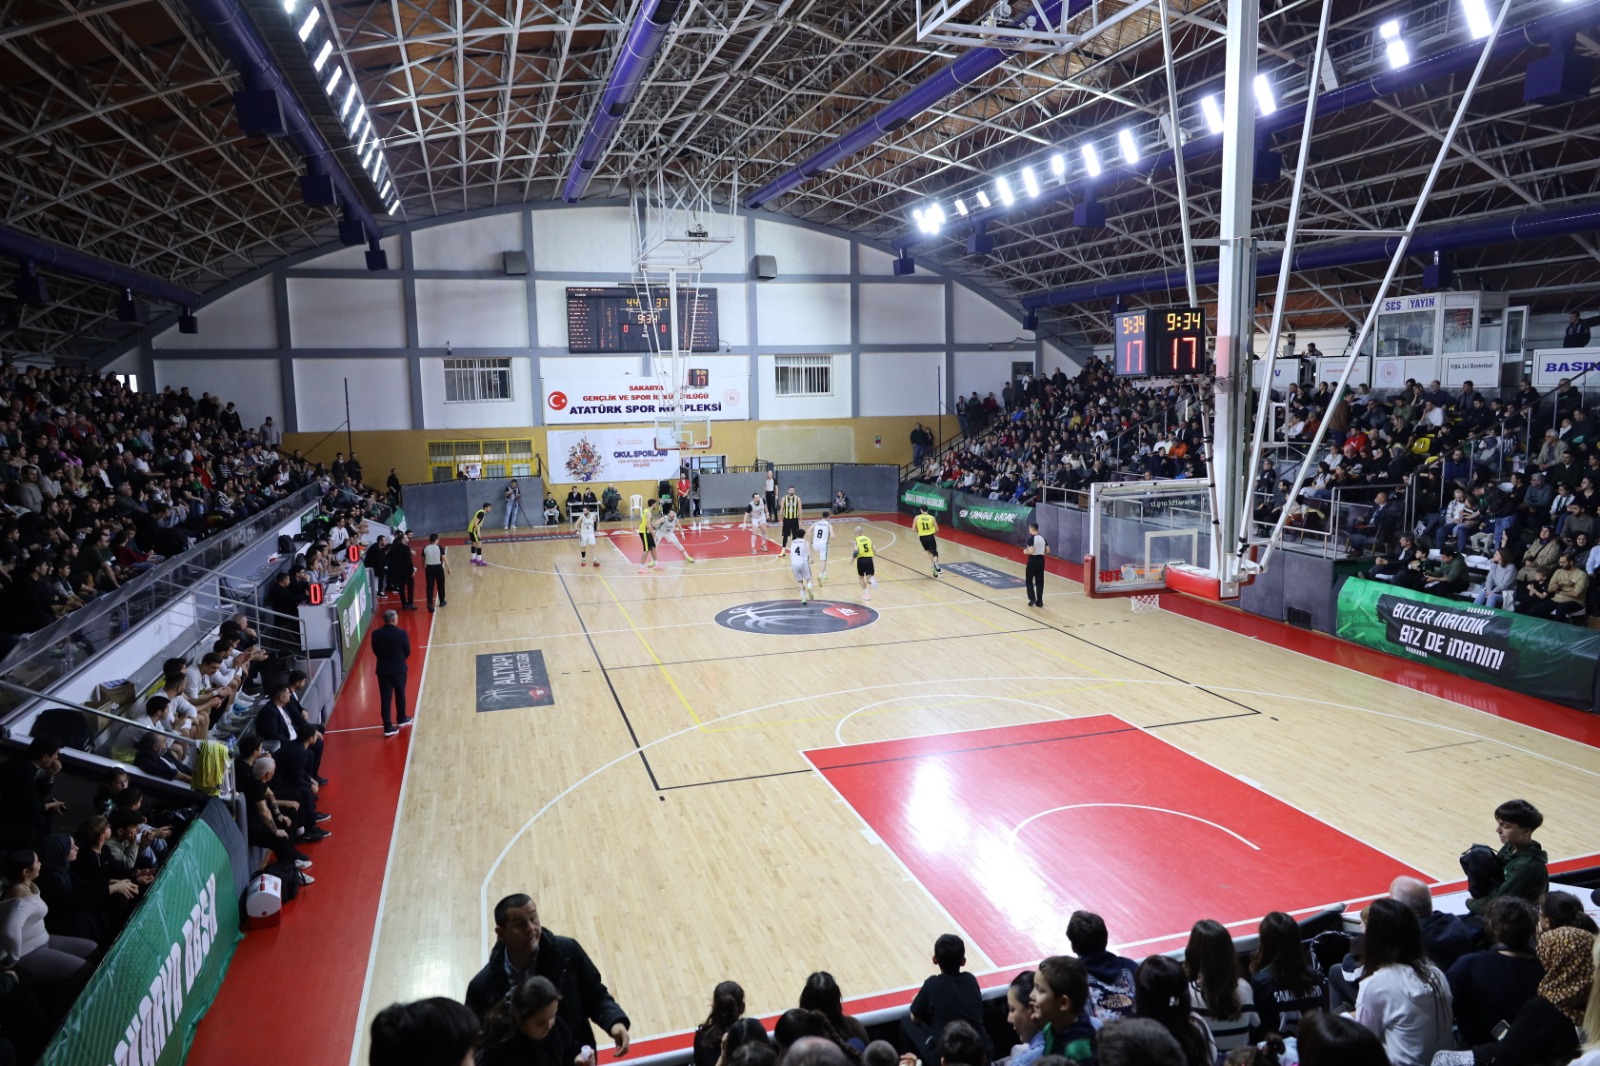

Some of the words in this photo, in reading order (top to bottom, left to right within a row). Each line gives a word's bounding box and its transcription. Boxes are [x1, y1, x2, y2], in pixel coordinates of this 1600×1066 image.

[626, 298, 639, 307] 44
[656, 298, 668, 308] 37
[1385, 300, 1402, 312] SES
[1409, 297, 1436, 310] YAYIN
[1122, 314, 1145, 334] 9:34
[1166, 312, 1201, 331] 9:34
[624, 324, 628, 333] 0
[661, 324, 666, 333] 0
[1126, 340, 1144, 372] 17
[1172, 336, 1197, 370] 17
[582, 394, 616, 402] GENÇLİK
[570, 404, 622, 415] ATATÜRK
[626, 404, 656, 414] SPOR
[613, 450, 633, 459] OKUL
[634, 449, 669, 458] SPORLARI
[922, 522, 930, 530] 11
[816, 528, 823, 539] 8
[794, 546, 801, 556] 4
[863, 543, 869, 553] 5
[310, 584, 322, 604] 0
[1392, 602, 1436, 624] BİZLER
[1424, 631, 1446, 654] DE
[1446, 638, 1506, 670] İNANIN!
[492, 654, 516, 685] ALTYAPI
